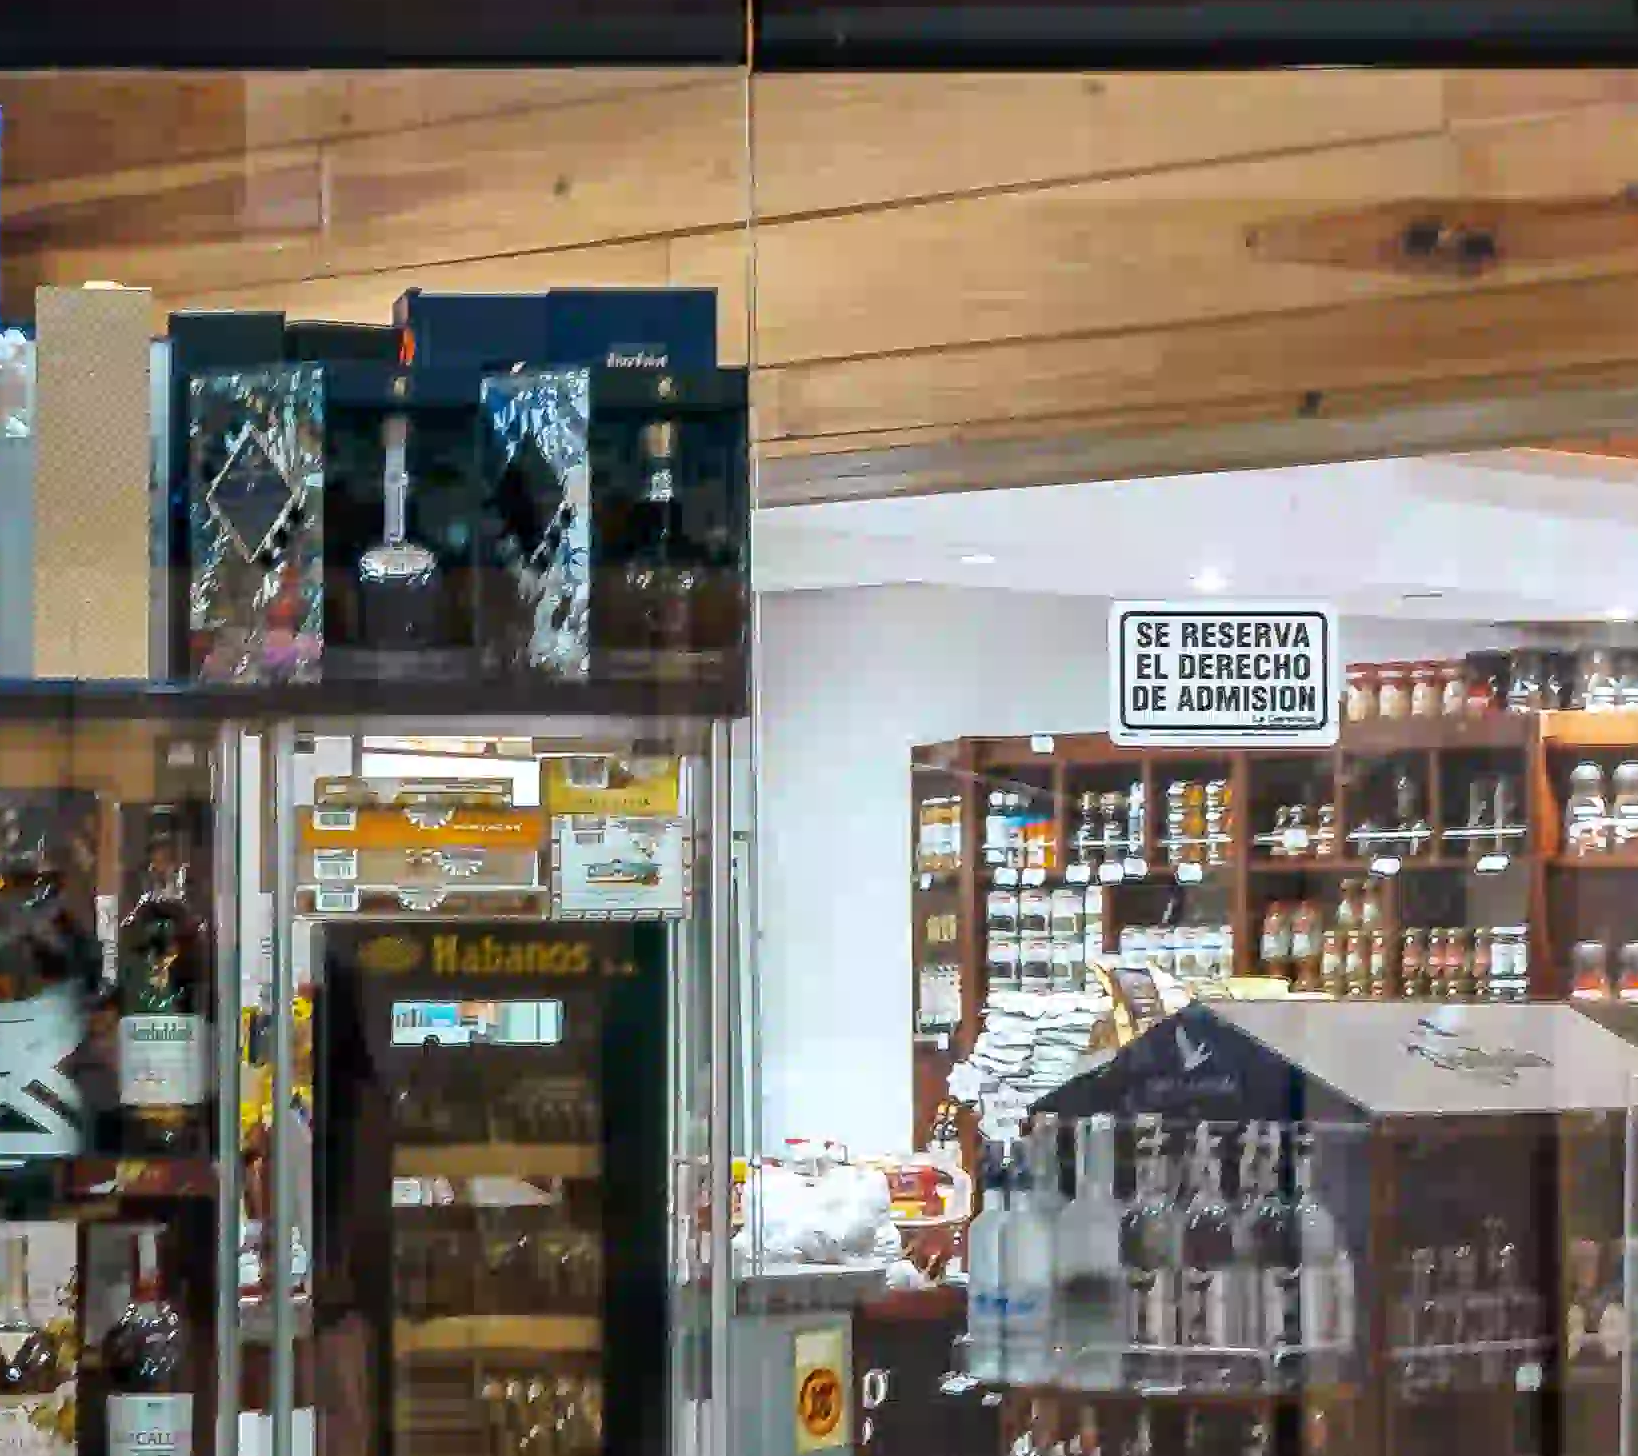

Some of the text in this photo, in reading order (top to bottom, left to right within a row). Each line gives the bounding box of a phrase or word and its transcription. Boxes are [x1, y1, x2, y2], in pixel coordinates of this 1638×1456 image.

[1136, 622, 1310, 648] SE RESERVA
[1136, 653, 1311, 681] EL DERECHO
[1132, 685, 1316, 712] DE ADMISION
[431, 932, 590, 975] Habanos
